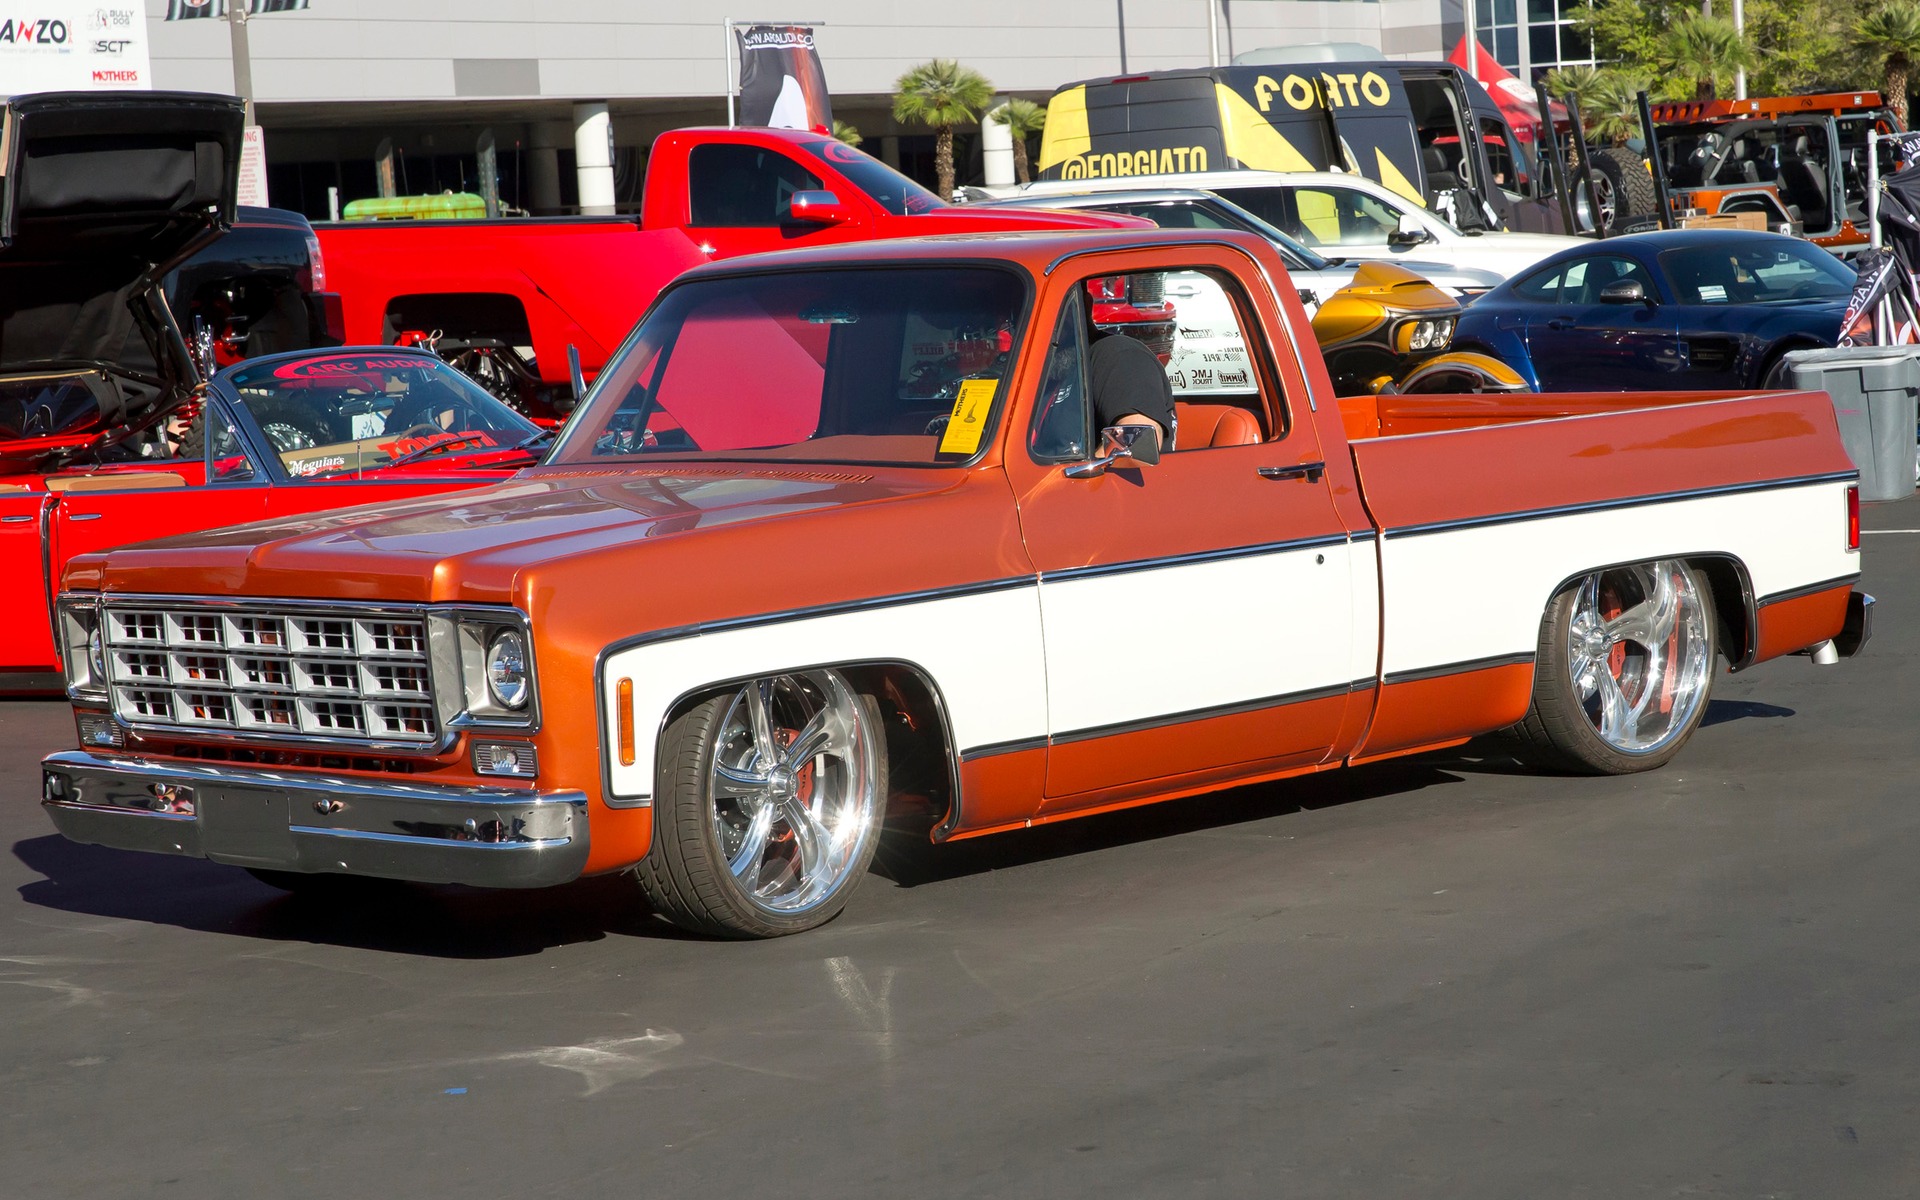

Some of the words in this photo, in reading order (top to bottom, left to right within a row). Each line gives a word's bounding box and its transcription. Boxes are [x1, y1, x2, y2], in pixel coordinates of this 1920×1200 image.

[110, 10, 134, 18] BULLY
[0, 19, 67, 44] ANZO
[96, 40, 131, 53] SCT
[92, 71, 138, 82] MOTHERS
[306, 362, 357, 375] ARC
[365, 360, 436, 369] AUDIO
[954, 388, 968, 416] MOTHERS
[288, 456, 345, 477] Meguiar's
